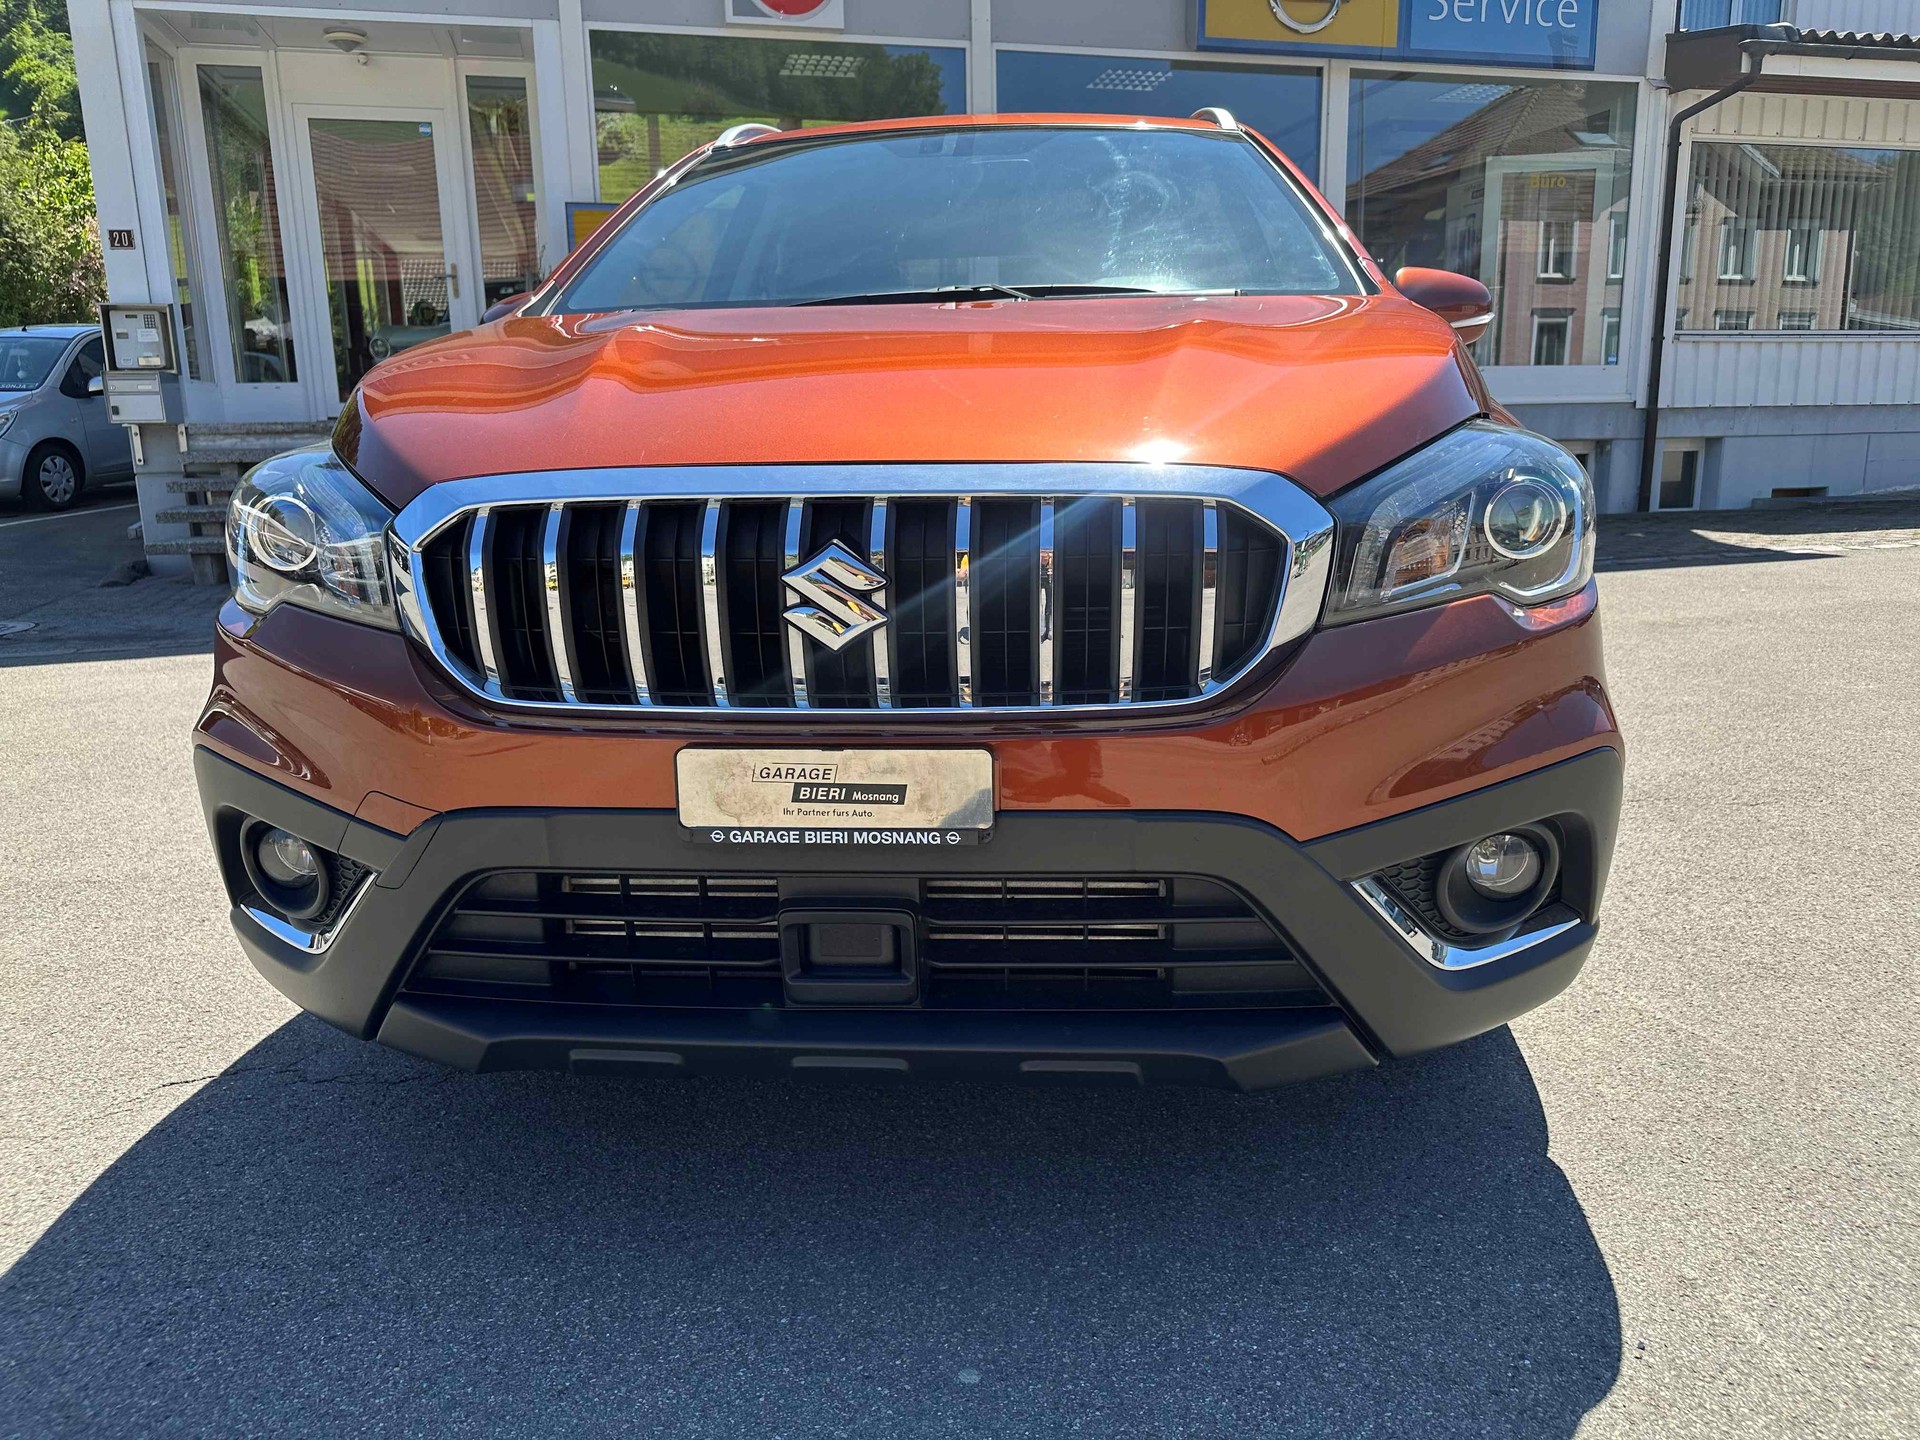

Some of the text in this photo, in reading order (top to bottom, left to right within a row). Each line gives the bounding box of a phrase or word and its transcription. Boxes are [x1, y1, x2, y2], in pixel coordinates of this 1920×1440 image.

[1530, 174, 1567, 188] Büro
[112, 231, 129, 247] 20
[759, 767, 833, 780] GARAGE
[799, 787, 899, 803] BIERI Mosnang
[783, 807, 795, 816] Ihr
[797, 807, 831, 817] Partner
[852, 809, 875, 818] Auto.
[729, 830, 941, 845] GARAGE BIERI MOSNANG
